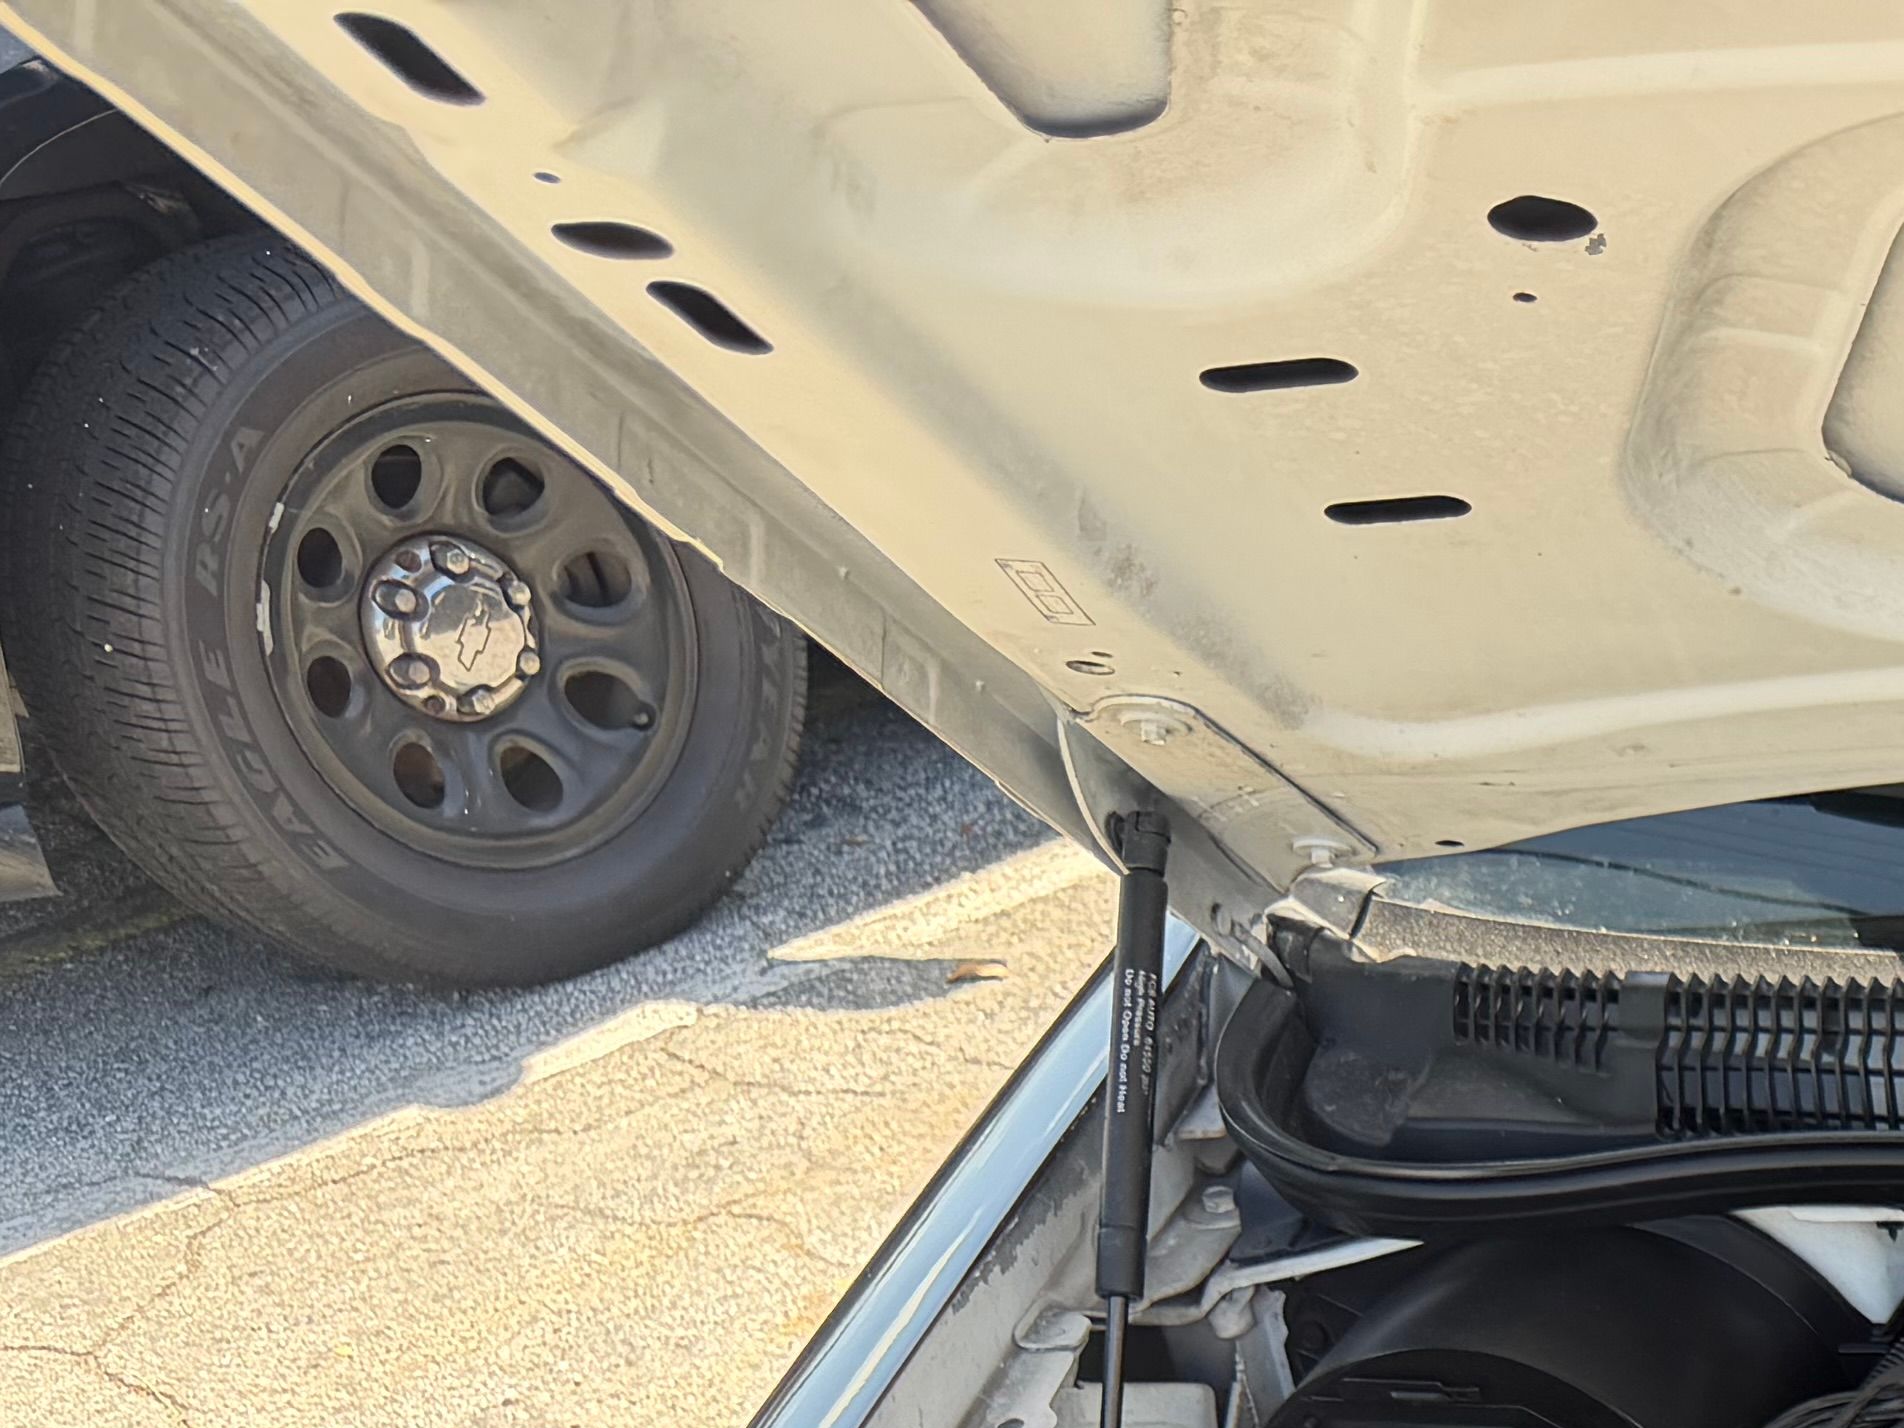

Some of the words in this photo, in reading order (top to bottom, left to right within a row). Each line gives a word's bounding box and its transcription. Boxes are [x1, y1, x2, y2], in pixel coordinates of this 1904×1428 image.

[199, 638, 351, 875] EAGLE
[1124, 968, 1135, 986] Do
[1123, 988, 1133, 1008] not
[1121, 1009, 1132, 1042] Open
[1119, 1043, 1130, 1062] Do
[1118, 1062, 1128, 1083] not
[1116, 1084, 1127, 1114] Heat
